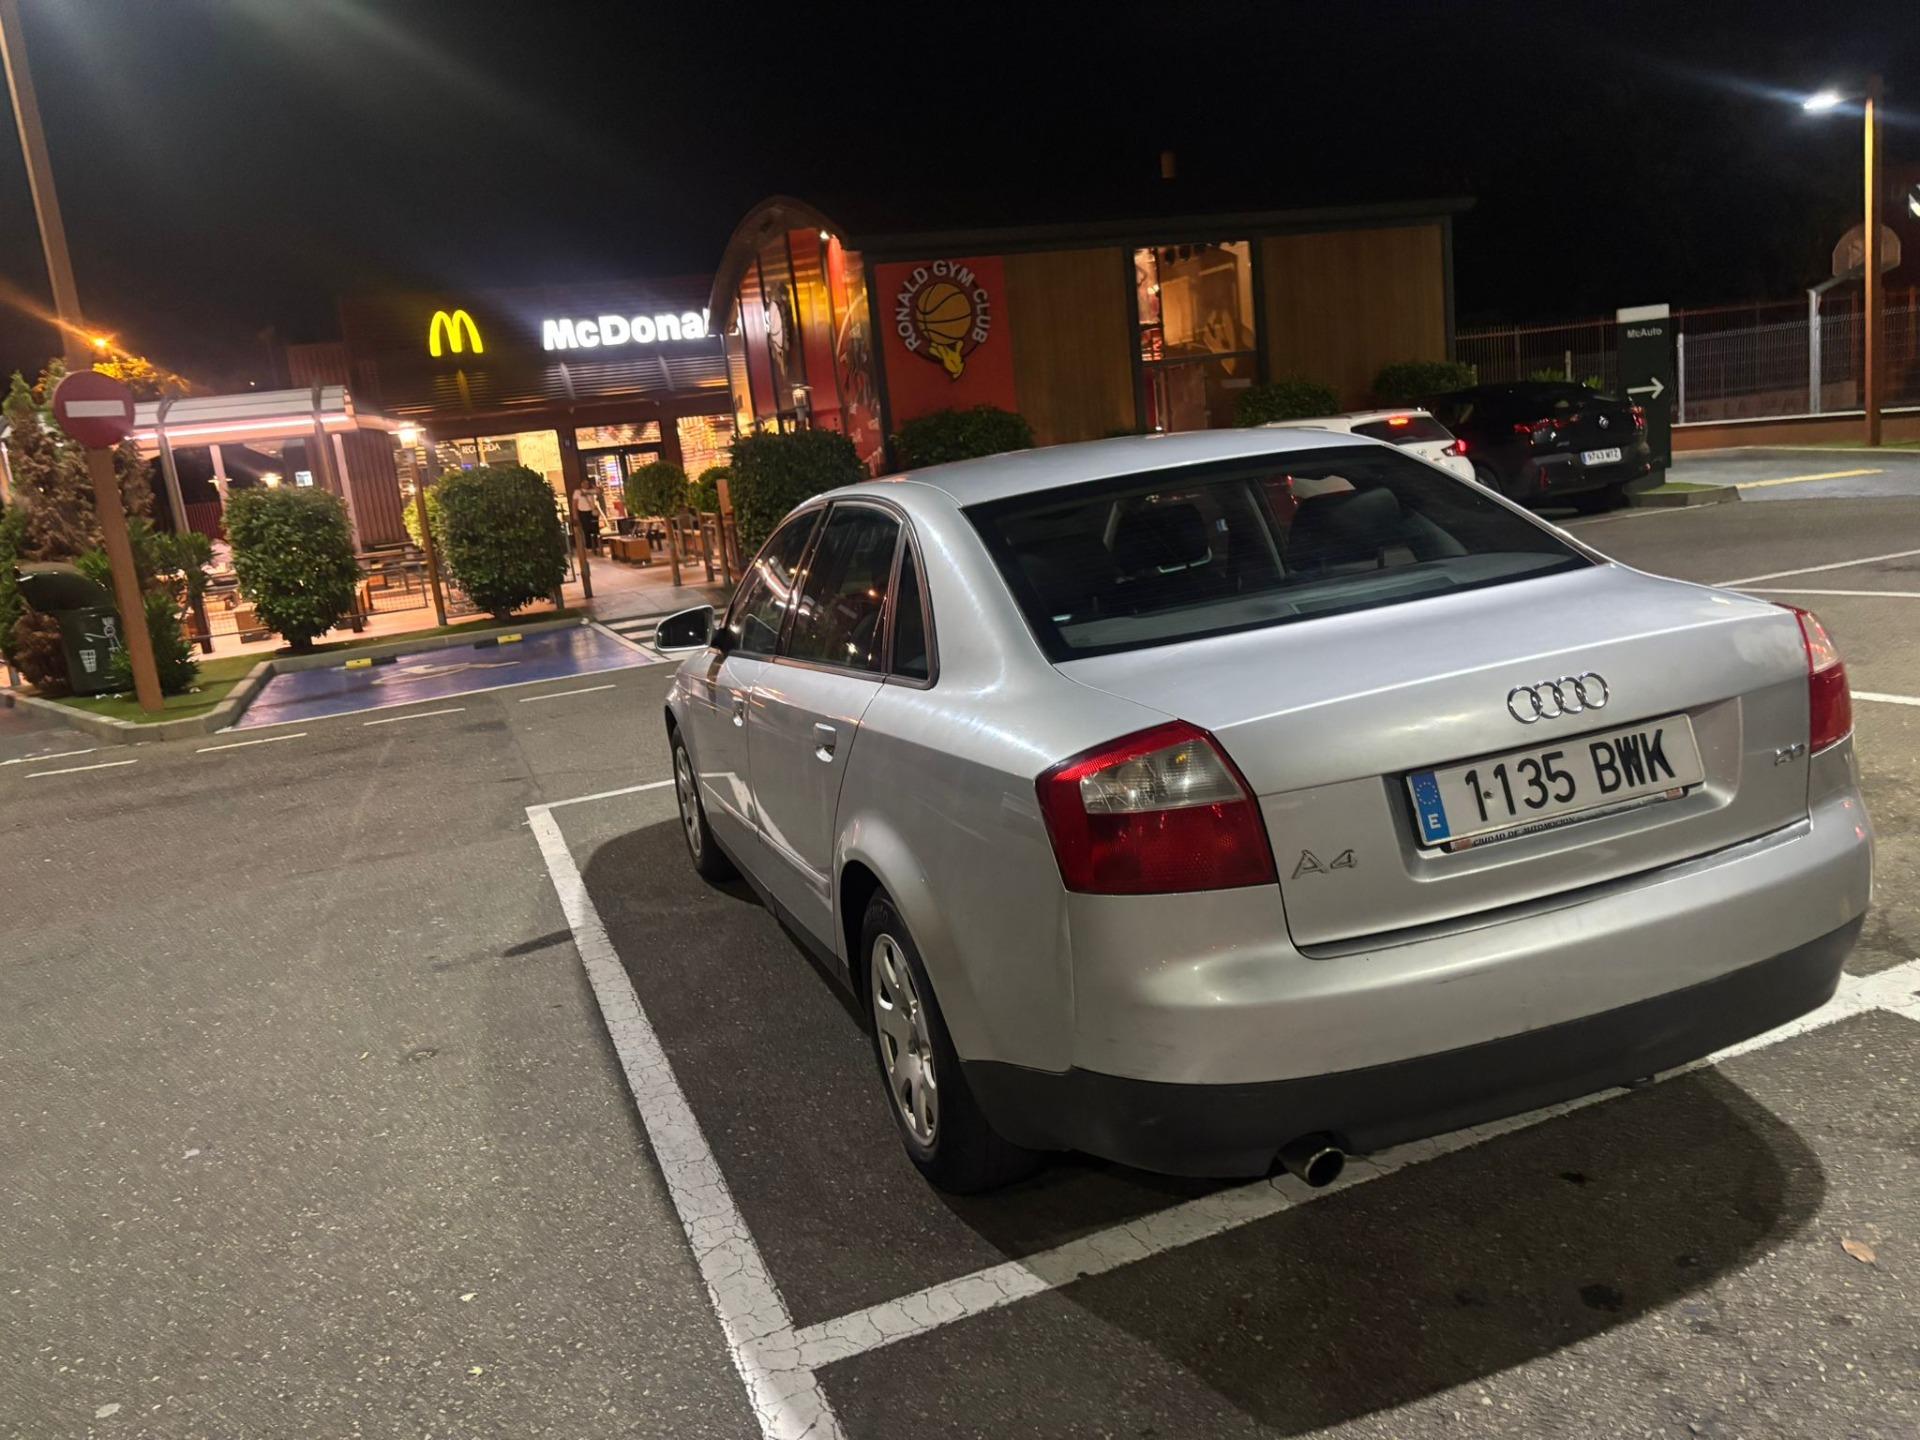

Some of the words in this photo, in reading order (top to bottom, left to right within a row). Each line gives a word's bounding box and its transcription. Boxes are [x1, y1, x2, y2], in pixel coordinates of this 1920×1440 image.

[895, 267, 928, 352] RONALD
[933, 260, 975, 287] GYM
[972, 289, 992, 343] CLUB
[542, 307, 711, 351] McDonal
[1627, 327, 1663, 338] McAuto
[1464, 751, 1576, 822] 1135
[1589, 729, 1676, 794] BWK
[1428, 813, 1441, 829] E
[1473, 832, 1505, 847] CIUDAD
[1507, 829, 1521, 838] DE
[1291, 849, 1358, 879] A4
